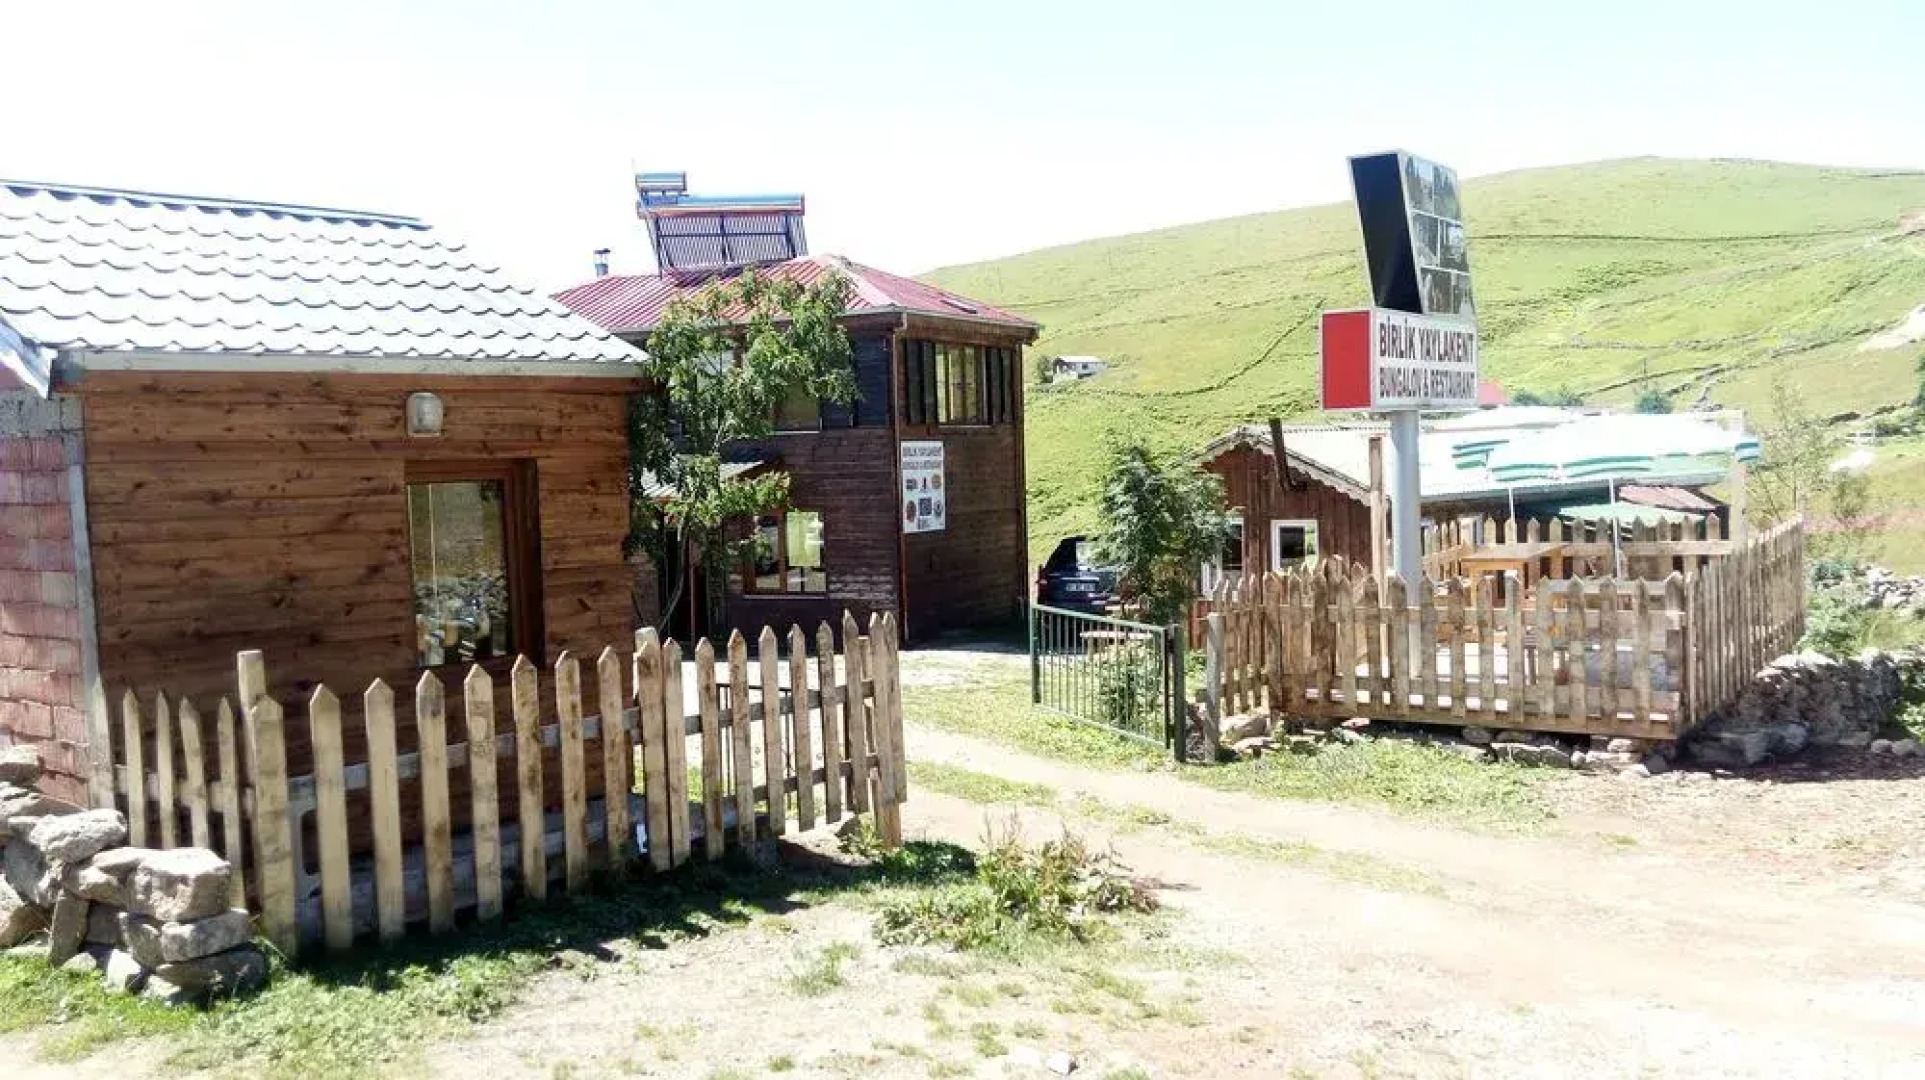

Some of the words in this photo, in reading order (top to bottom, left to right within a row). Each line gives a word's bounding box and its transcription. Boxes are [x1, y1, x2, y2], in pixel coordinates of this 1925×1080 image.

[1379, 315, 1416, 360] BİRLİK
[1418, 326, 1475, 364] YAYLAKENT
[1379, 367, 1422, 398] BUNGALOV
